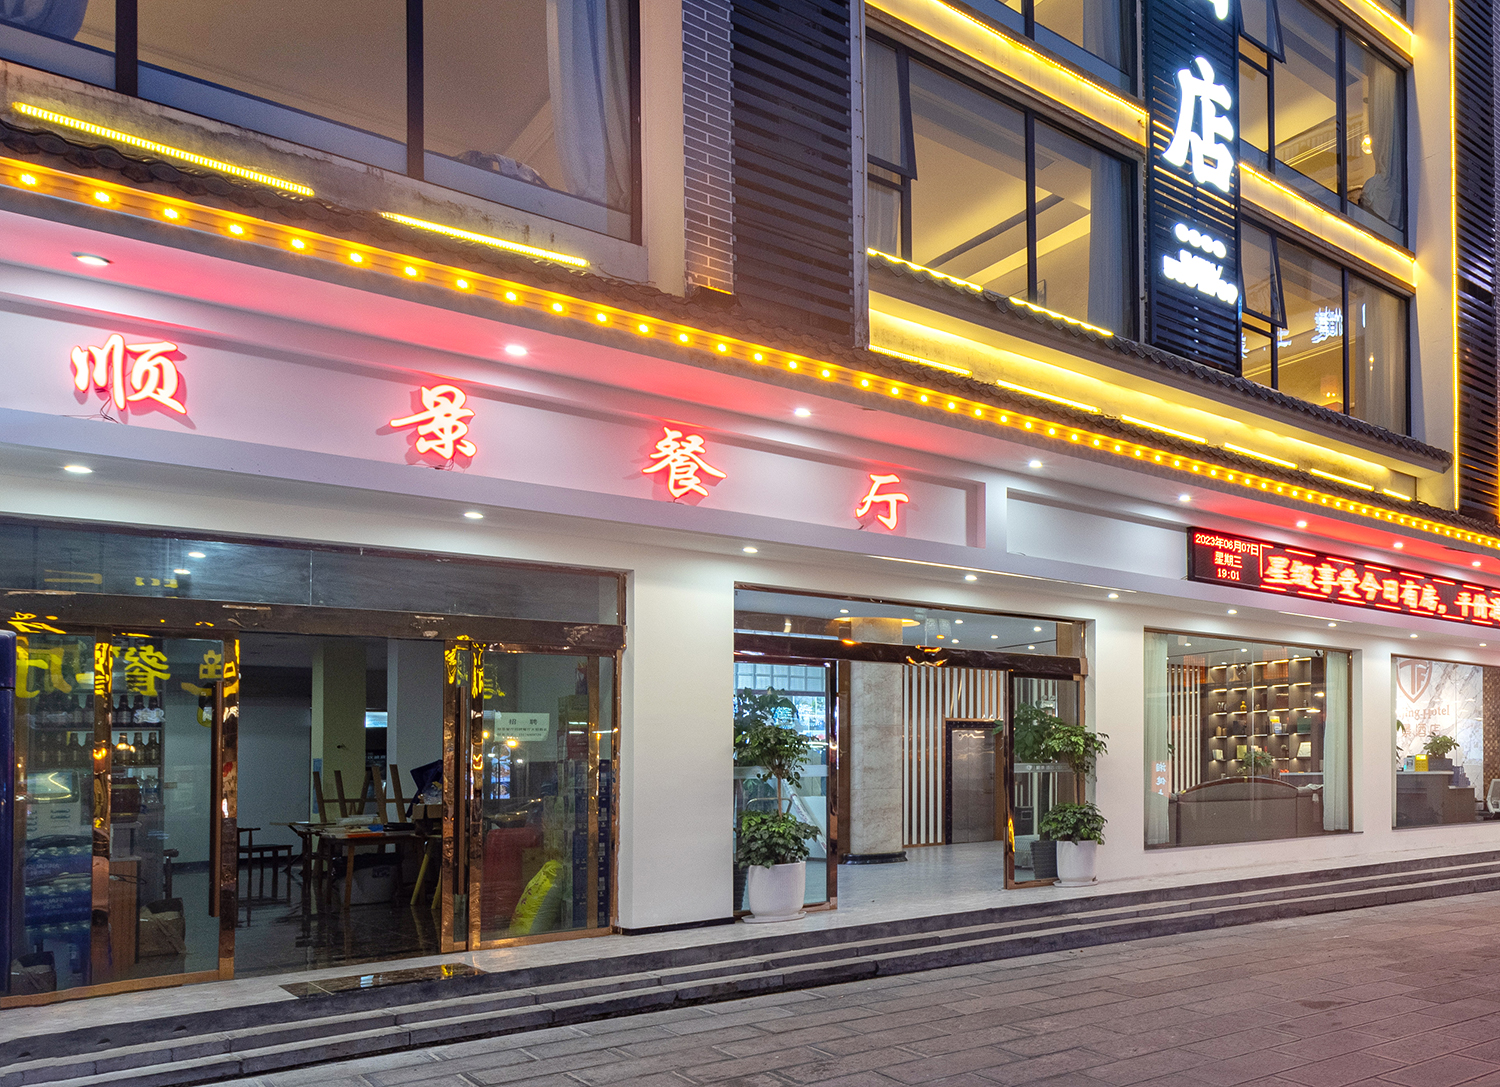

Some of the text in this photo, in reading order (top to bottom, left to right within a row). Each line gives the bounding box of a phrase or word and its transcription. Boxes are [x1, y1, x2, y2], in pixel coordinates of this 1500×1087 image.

[69, 332, 910, 532] 顺景餐厅
[1194, 533, 1260, 557] 2023年06月07日
[1214, 550, 1243, 569] 星期三
[1217, 567, 1241, 581] 19:01
[1422, 704, 1450, 720] Hotel
